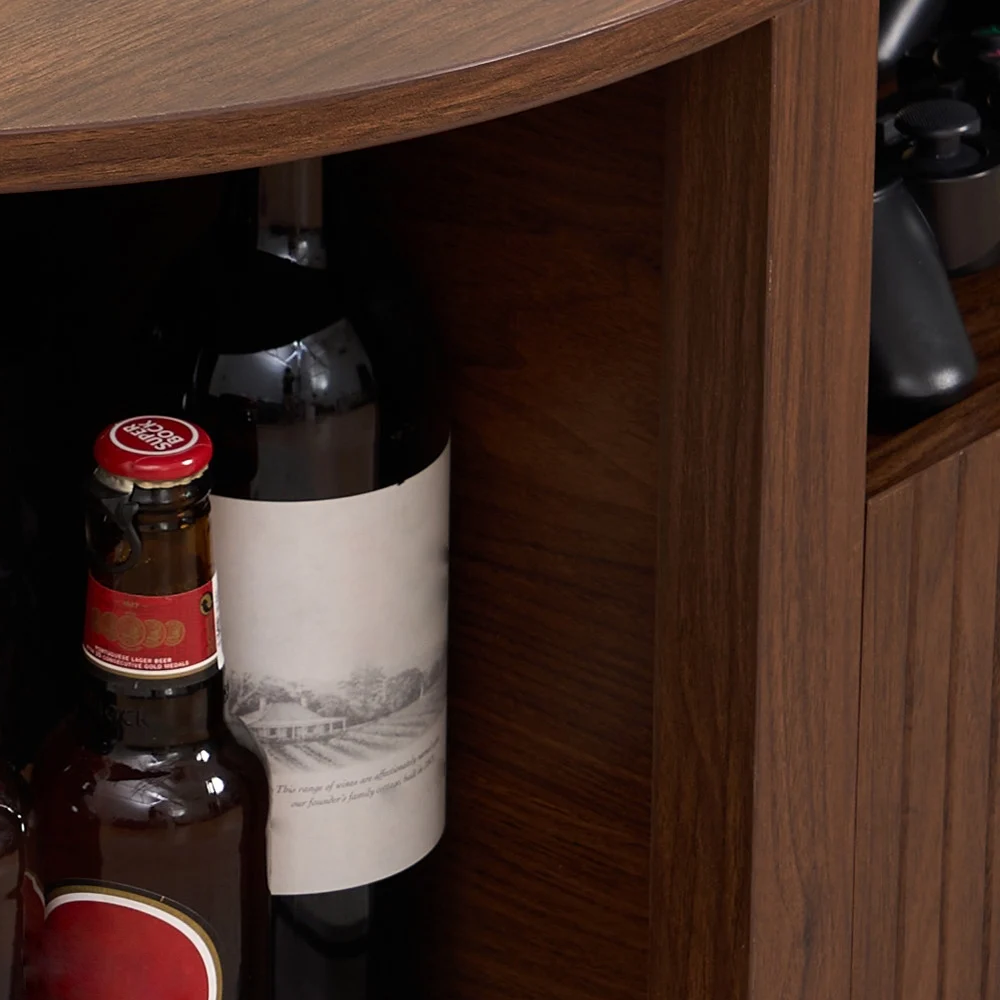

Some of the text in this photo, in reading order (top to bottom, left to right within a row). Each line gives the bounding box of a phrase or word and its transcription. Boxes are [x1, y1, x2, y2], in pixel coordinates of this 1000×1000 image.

[122, 423, 172, 451] SUPER
[139, 419, 185, 445] BOCK
[130, 656, 152, 664] LAGER
[163, 660, 190, 670] MEDALS
[298, 785, 323, 795] range
[324, 780, 336, 792] of
[359, 776, 372, 786] are
